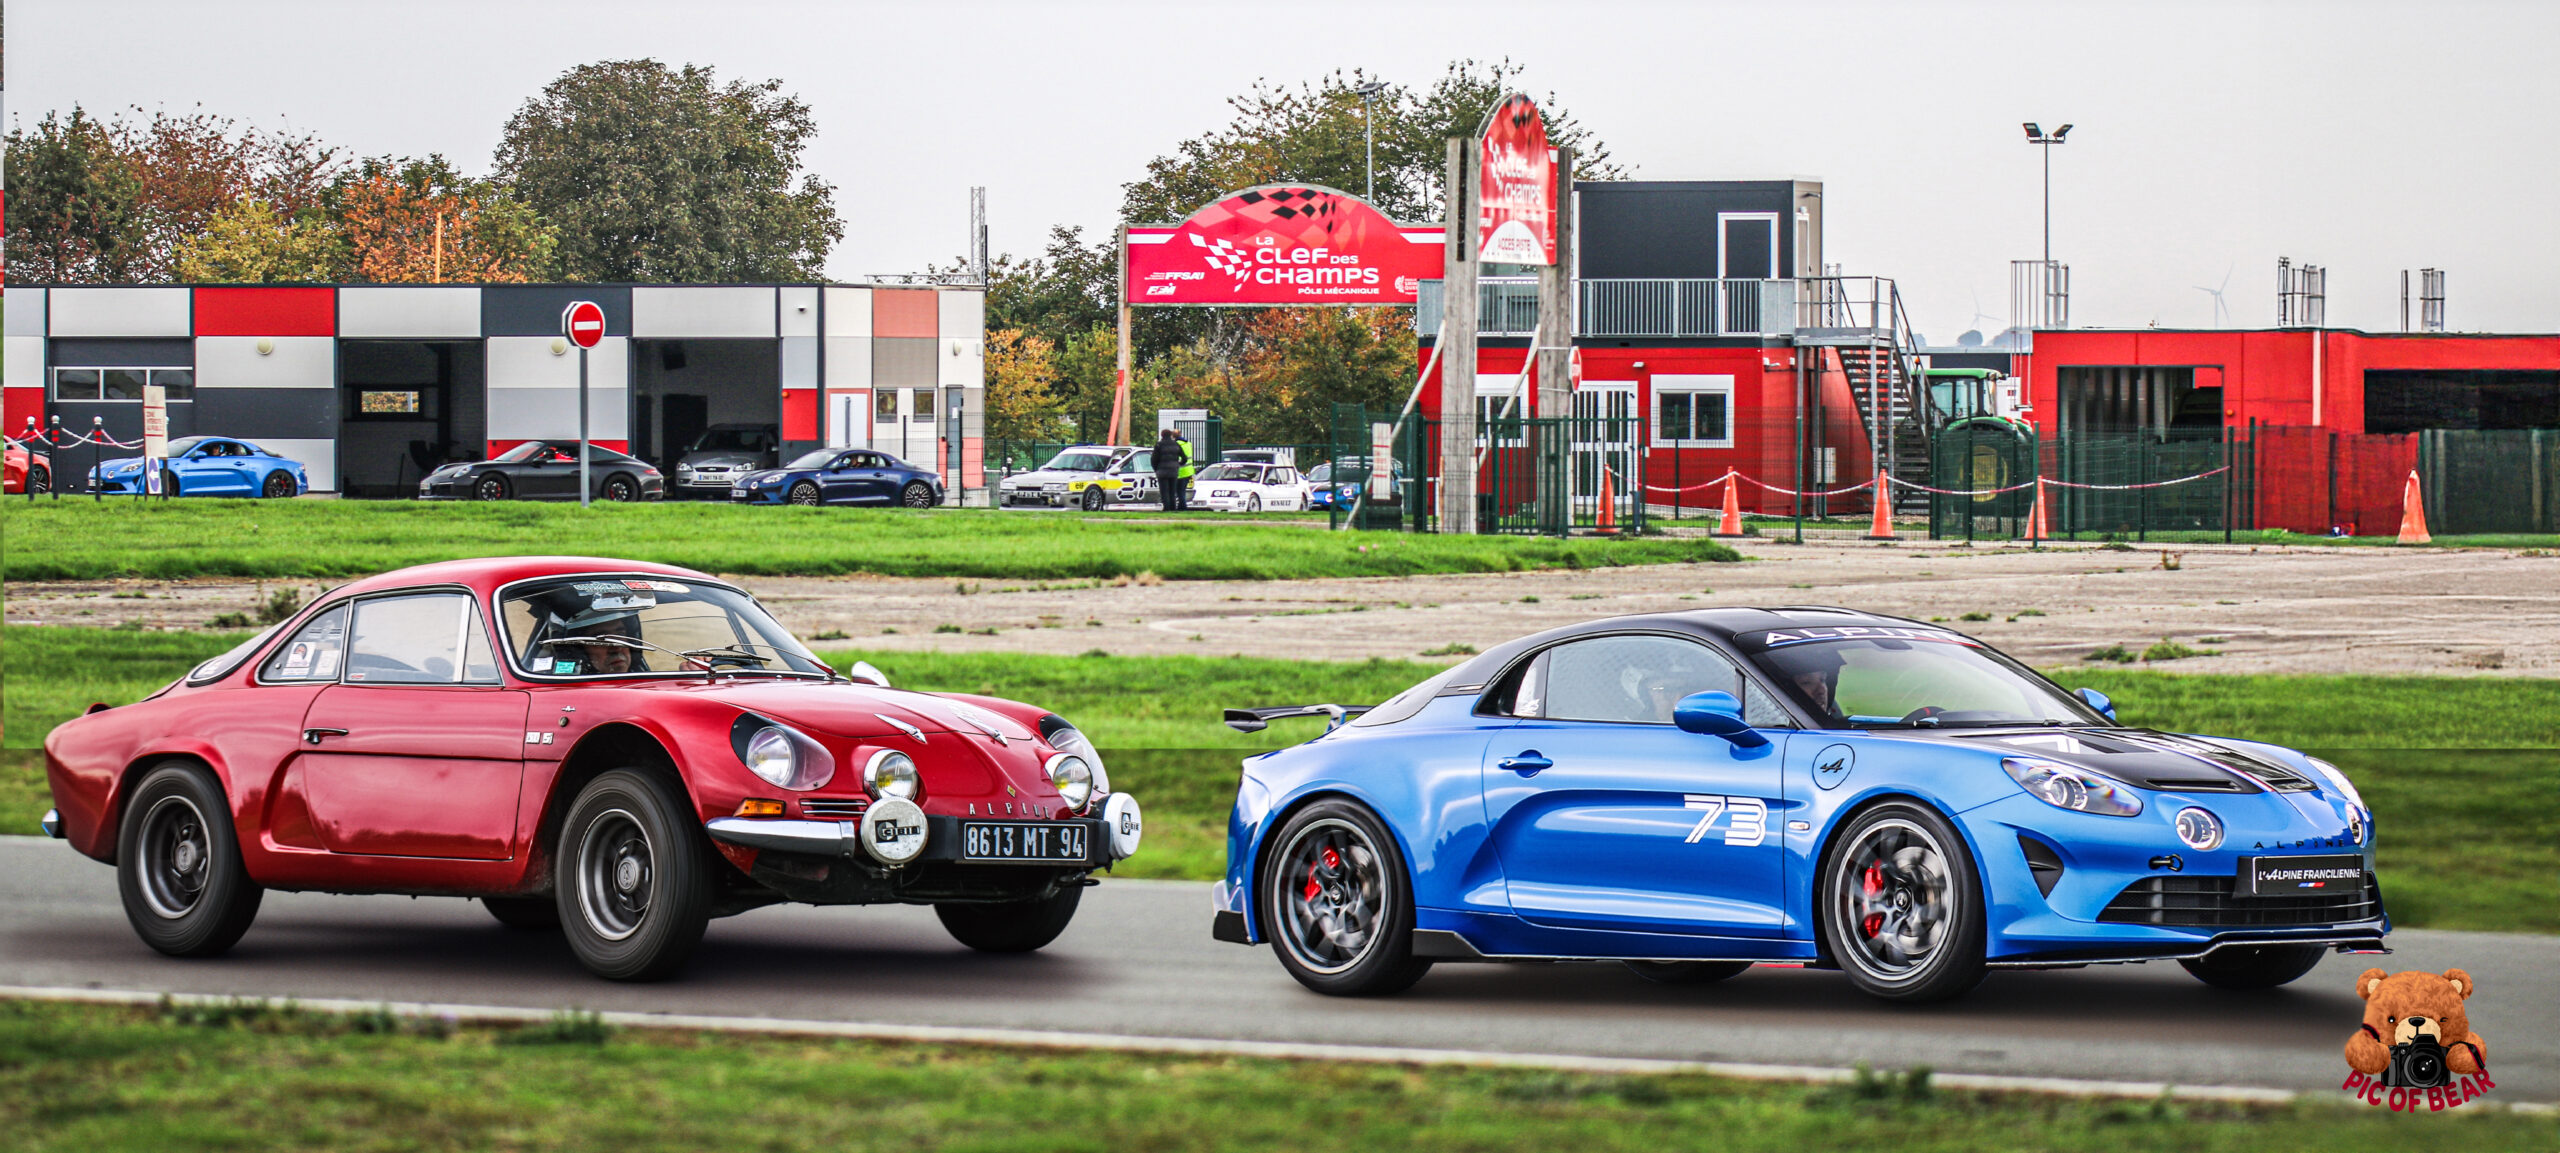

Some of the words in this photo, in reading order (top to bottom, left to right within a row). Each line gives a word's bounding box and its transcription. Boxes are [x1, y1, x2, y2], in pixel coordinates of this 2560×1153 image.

[1298, 286, 1322, 295] PÔLE
[1324, 286, 1380, 295] MÉCANIQUE
[1074, 481, 1085, 490] elf
[1766, 626, 1975, 645] ALPINE
[968, 802, 1052, 820] ALPINE
[1683, 794, 1768, 847] 73
[968, 826, 1014, 856] 8613
[1023, 827, 1051, 857] MT
[1060, 827, 1083, 857] 94
[2253, 839, 2344, 849] ALPINE
[2303, 868, 2361, 880] FRANCILIENNE
